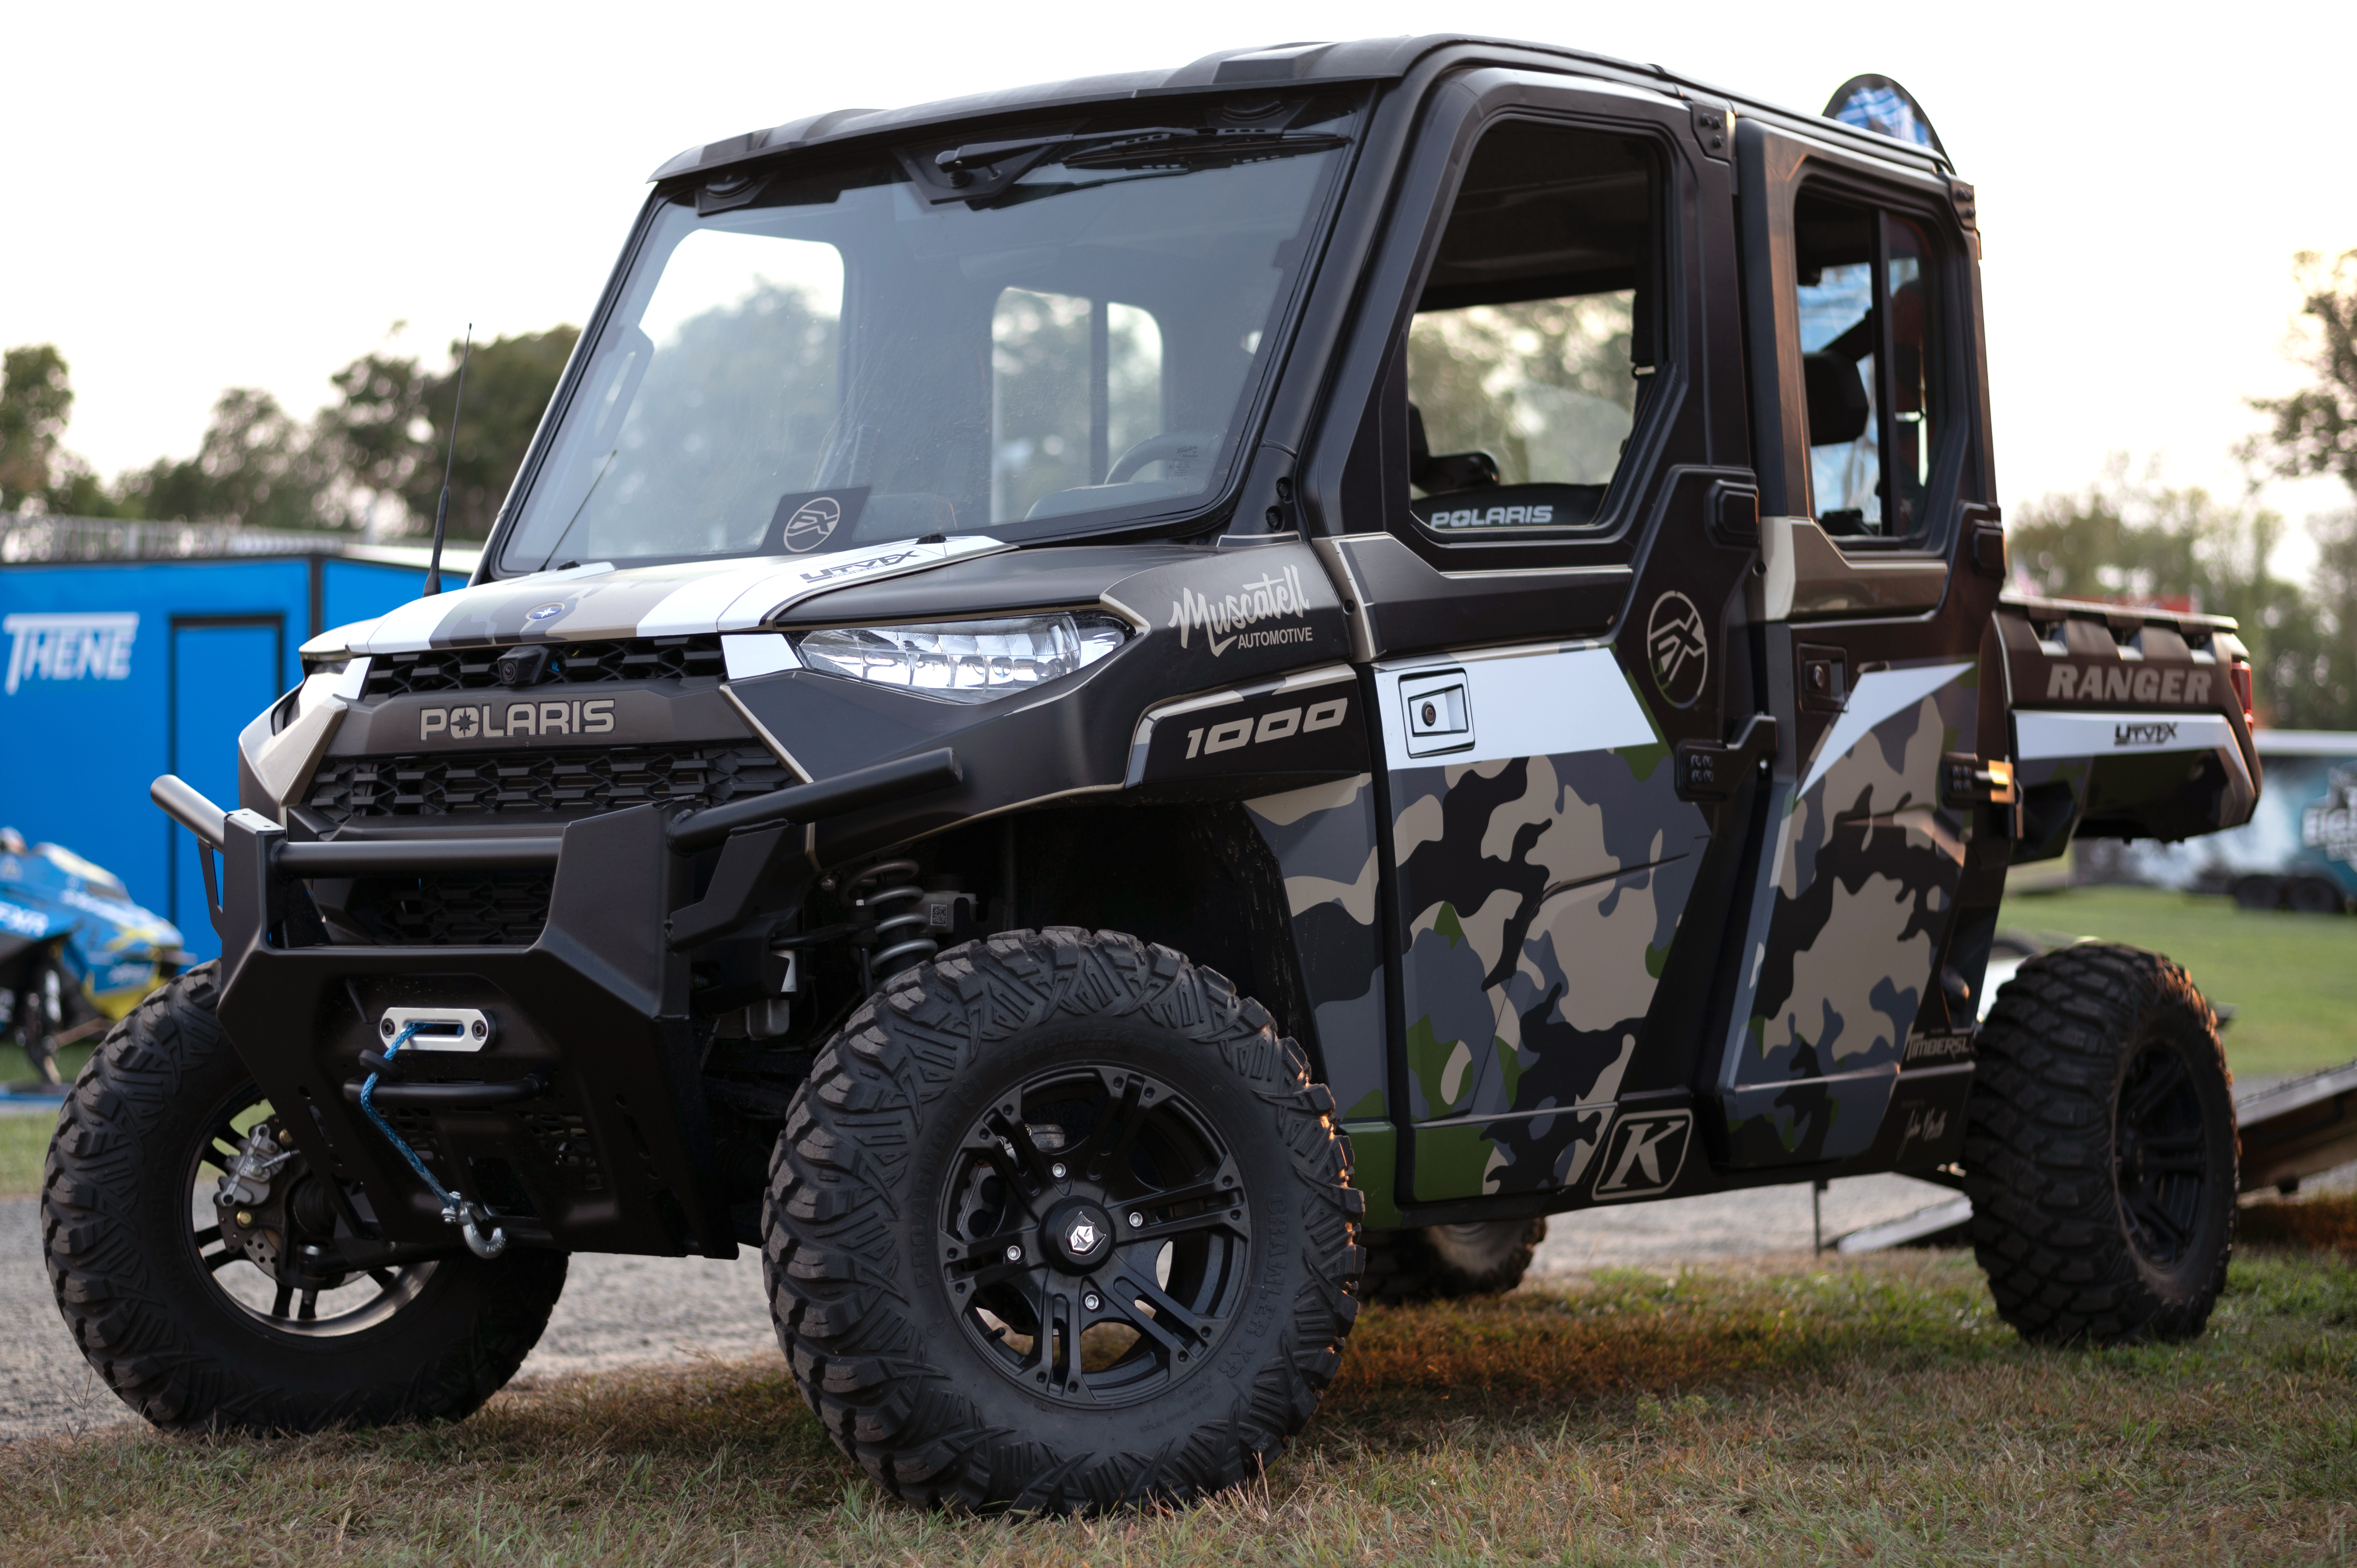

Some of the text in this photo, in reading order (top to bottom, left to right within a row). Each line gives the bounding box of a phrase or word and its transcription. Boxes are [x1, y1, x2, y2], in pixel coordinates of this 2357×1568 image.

[1430, 505, 1553, 528] POLARIS
[799, 550, 921, 583] UTVFX
[1167, 564, 1310, 657] Muscatell
[3, 612, 140, 696] THENE
[1237, 627, 1313, 649] AUTOMOTIVE
[2047, 663, 2213, 704] RANGER
[420, 699, 615, 741] POLARIS
[1185, 697, 1348, 759] 1000
[911, 1106, 961, 1216] ARMOR
[1217, 1193, 1288, 1384] CRAWLER XR
[1138, 1419, 1164, 1433] SERVICE
[1165, 1406, 1189, 1425] HIGHWAY
[1189, 1399, 1202, 1412] FOR
